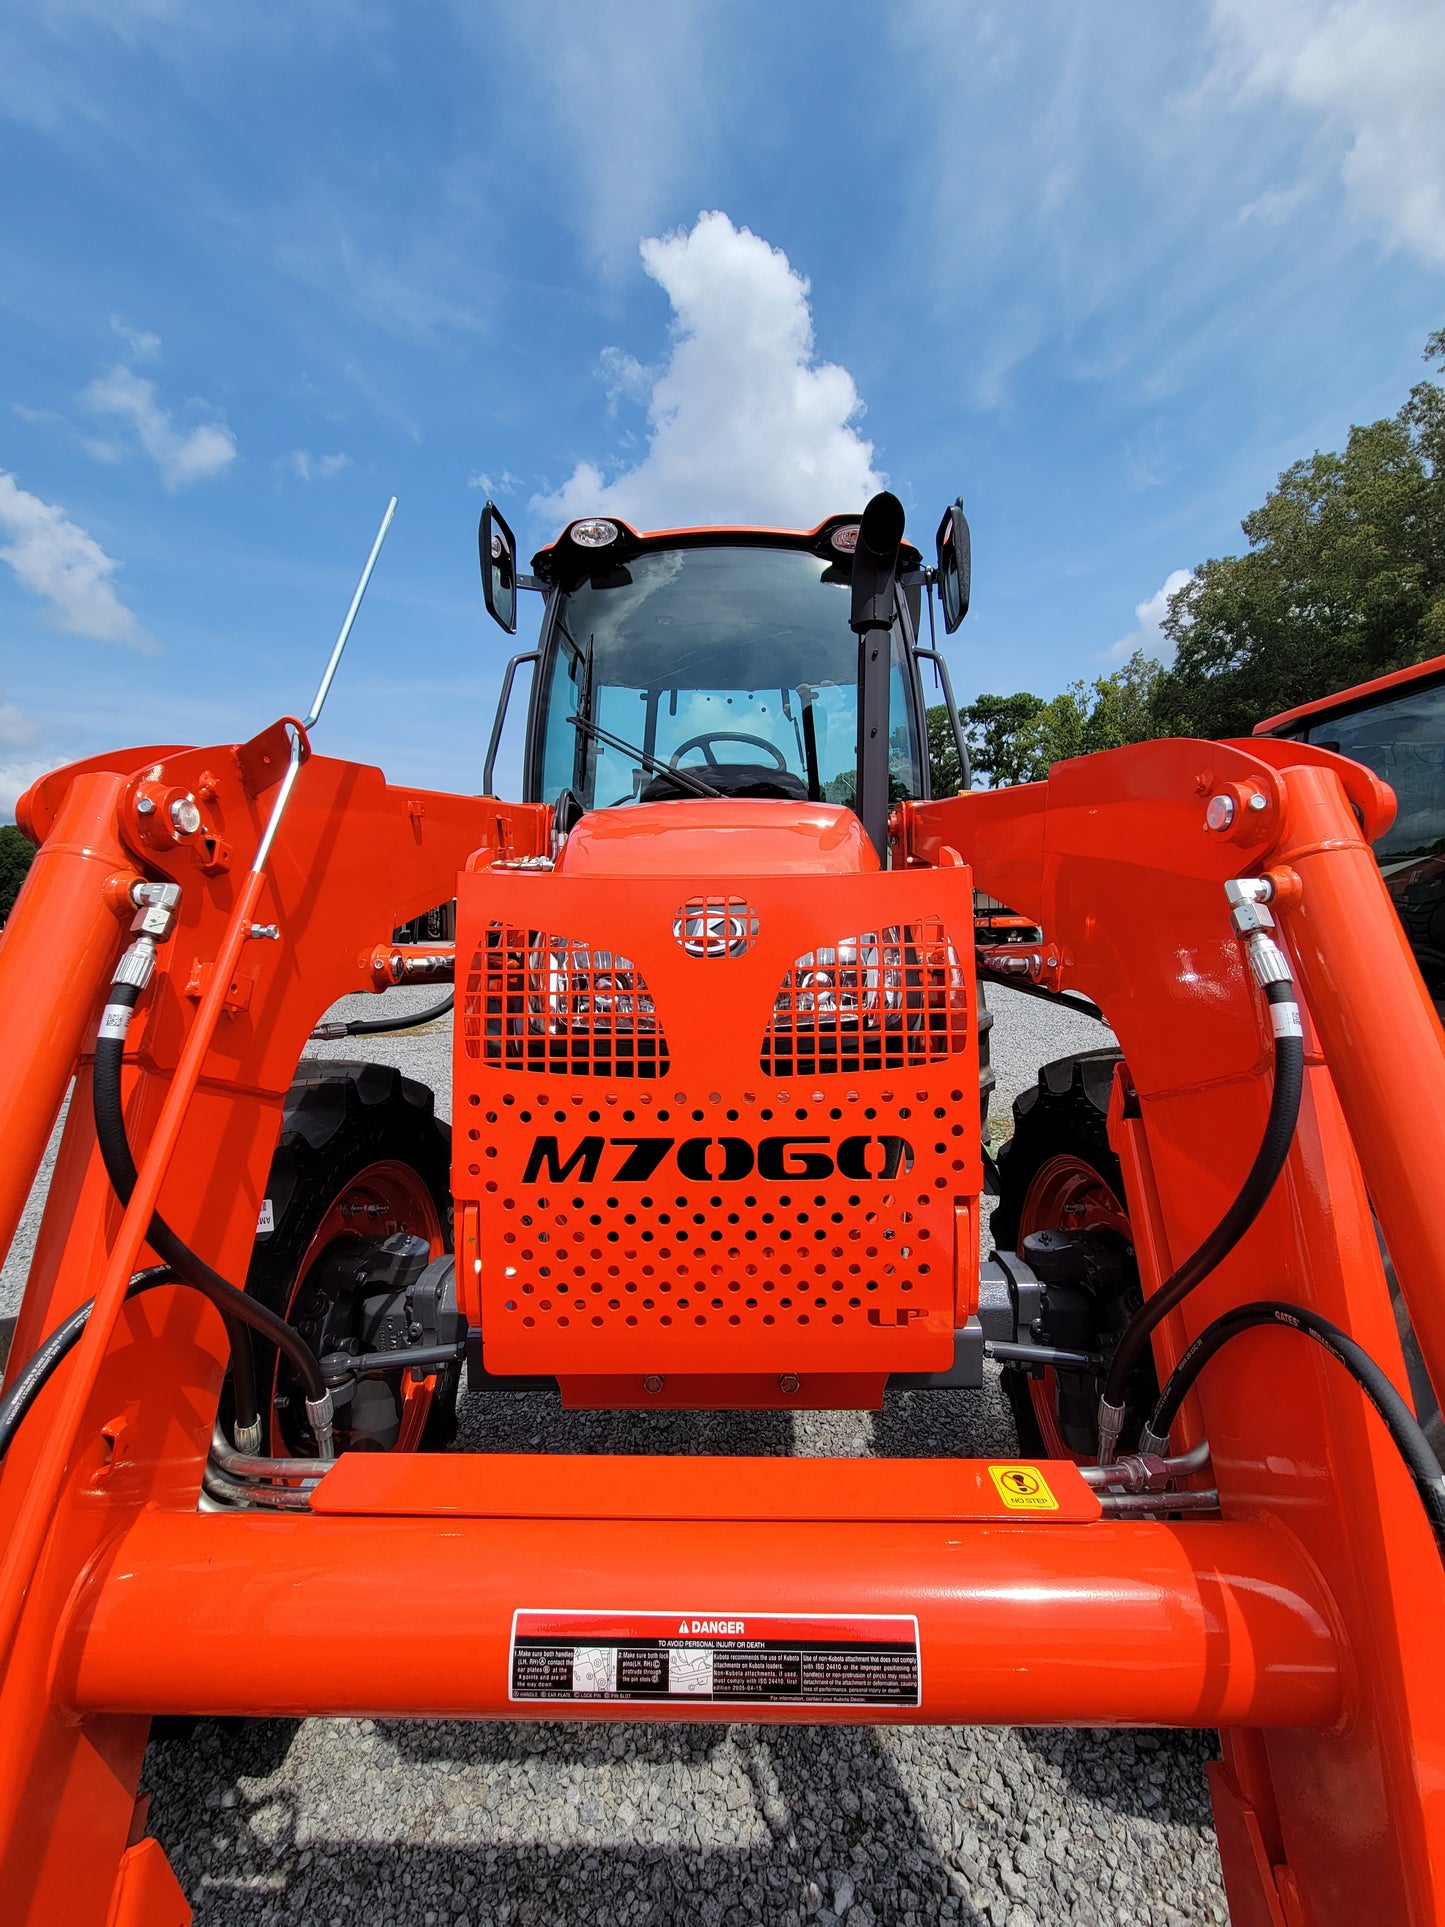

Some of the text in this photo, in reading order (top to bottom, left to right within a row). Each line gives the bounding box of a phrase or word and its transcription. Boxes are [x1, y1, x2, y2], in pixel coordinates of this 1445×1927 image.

[521, 1135, 914, 1184] M7060
[256, 1216, 270, 1225] AM
[1274, 1310, 1299, 1327] GATES
[692, 1621, 744, 1634] DANGER
